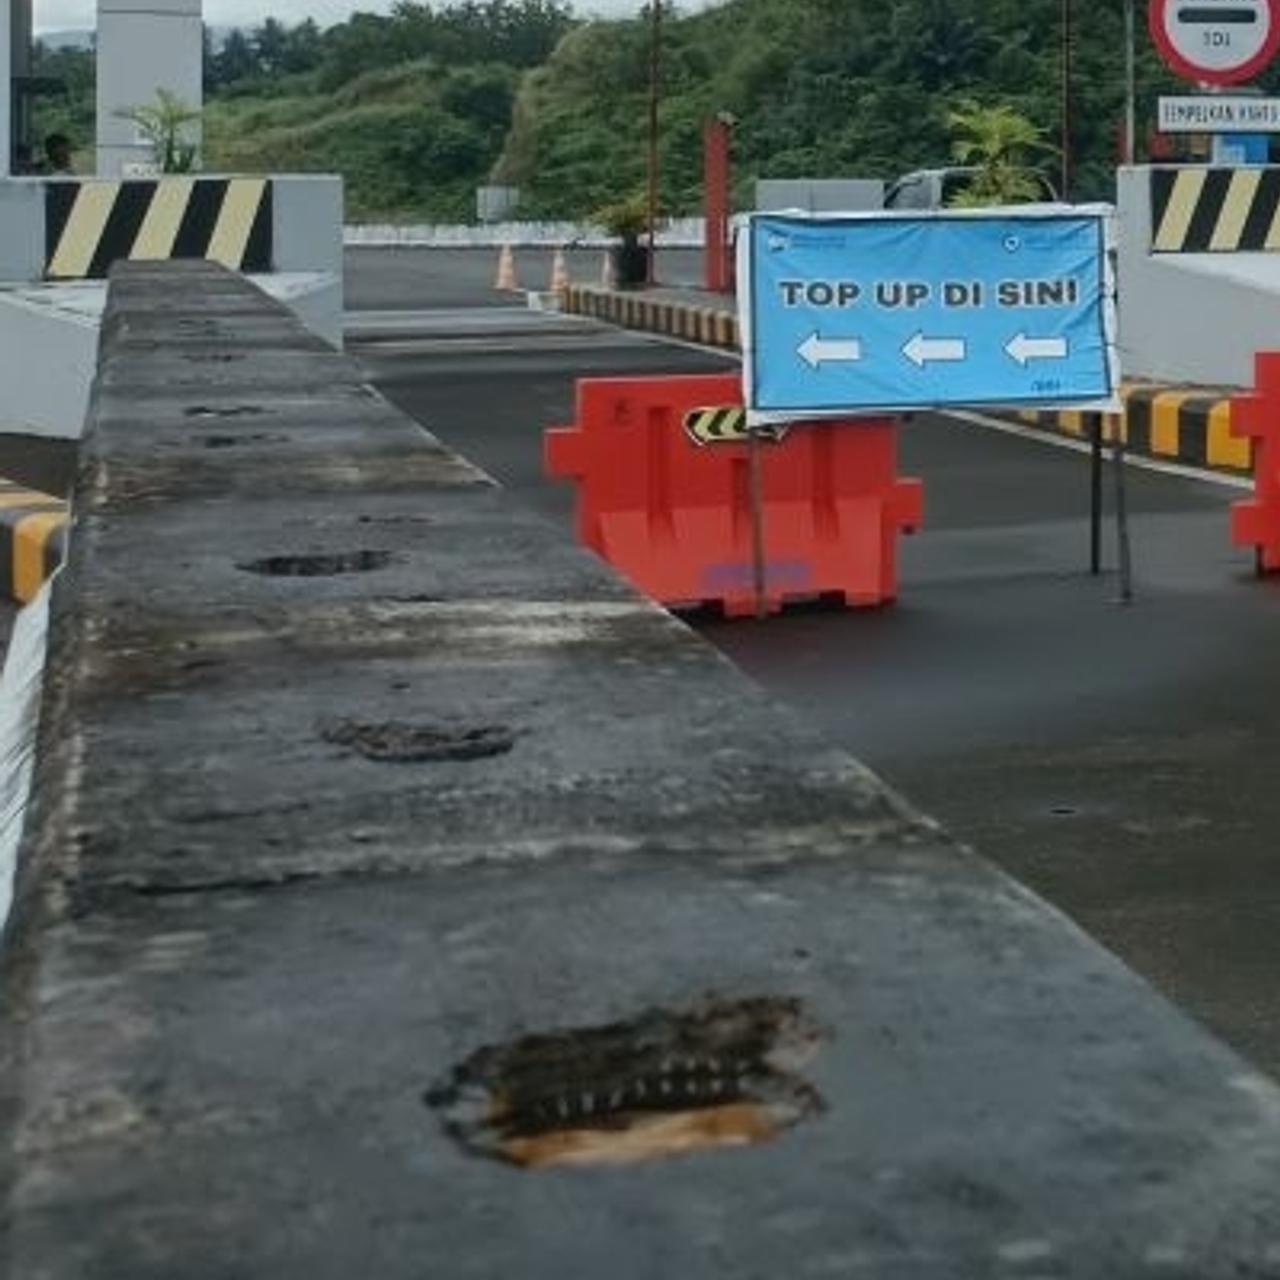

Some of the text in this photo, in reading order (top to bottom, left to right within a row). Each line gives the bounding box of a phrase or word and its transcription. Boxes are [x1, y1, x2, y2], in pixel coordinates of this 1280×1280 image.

[780, 279, 1078, 308] TOP UP DI SINI
